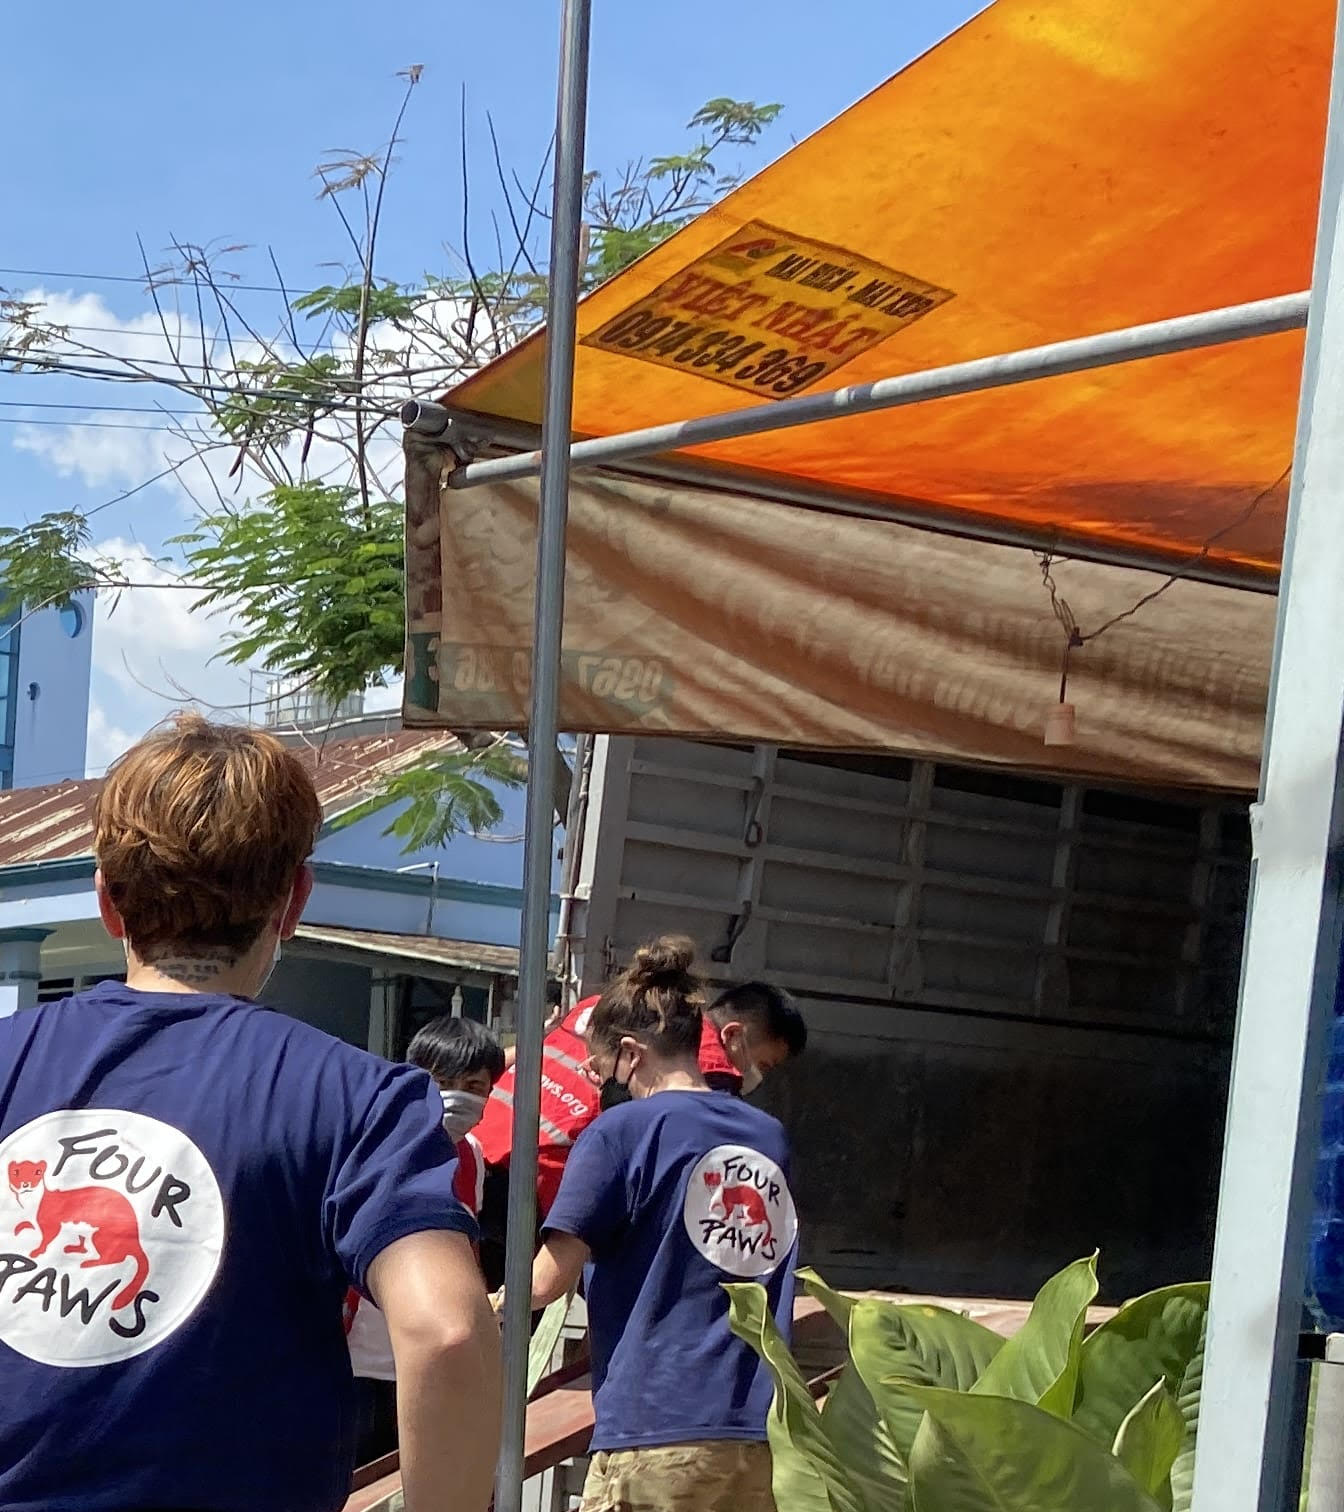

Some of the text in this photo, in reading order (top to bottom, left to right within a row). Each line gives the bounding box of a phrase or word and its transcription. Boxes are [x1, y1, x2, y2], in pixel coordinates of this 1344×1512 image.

[734, 348, 827, 392] 369
[52, 1129, 192, 1228] FOUR
[723, 1155, 781, 1207] FOUR
[699, 1219, 778, 1260] PAWS
